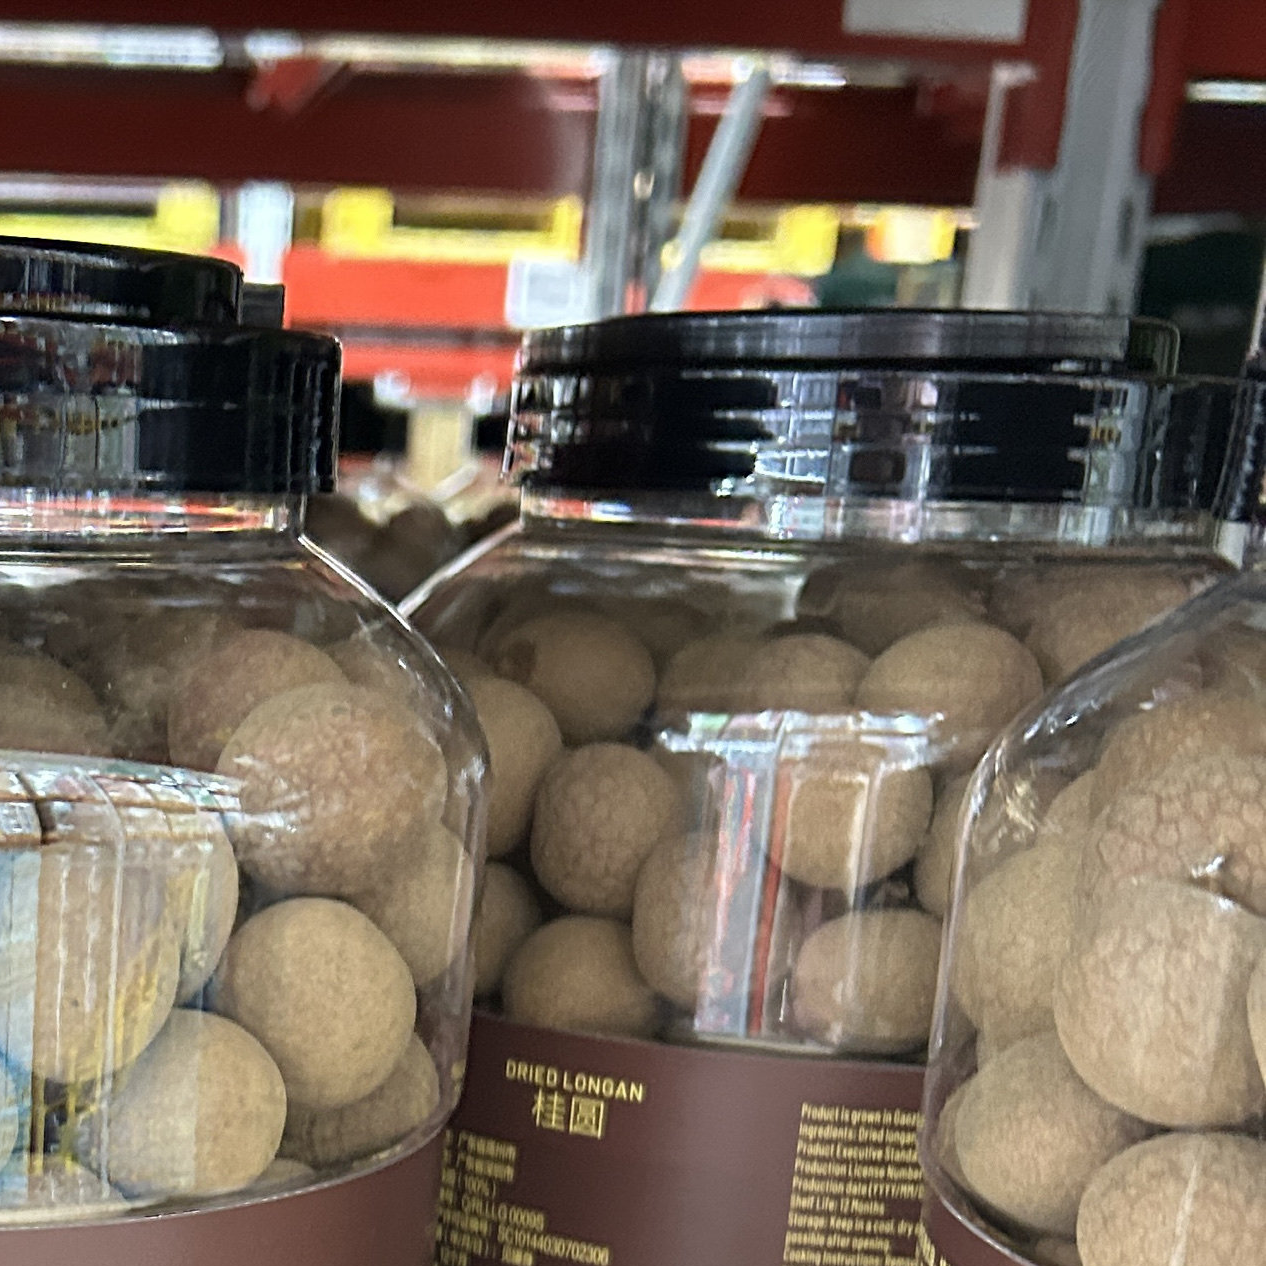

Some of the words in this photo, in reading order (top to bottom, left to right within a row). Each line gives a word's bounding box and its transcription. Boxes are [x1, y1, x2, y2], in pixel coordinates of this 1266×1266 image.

[505, 1057, 558, 1088] DRIED
[562, 1070, 644, 1103] LONGAN
[531, 1087, 605, 1139] 桂圆
